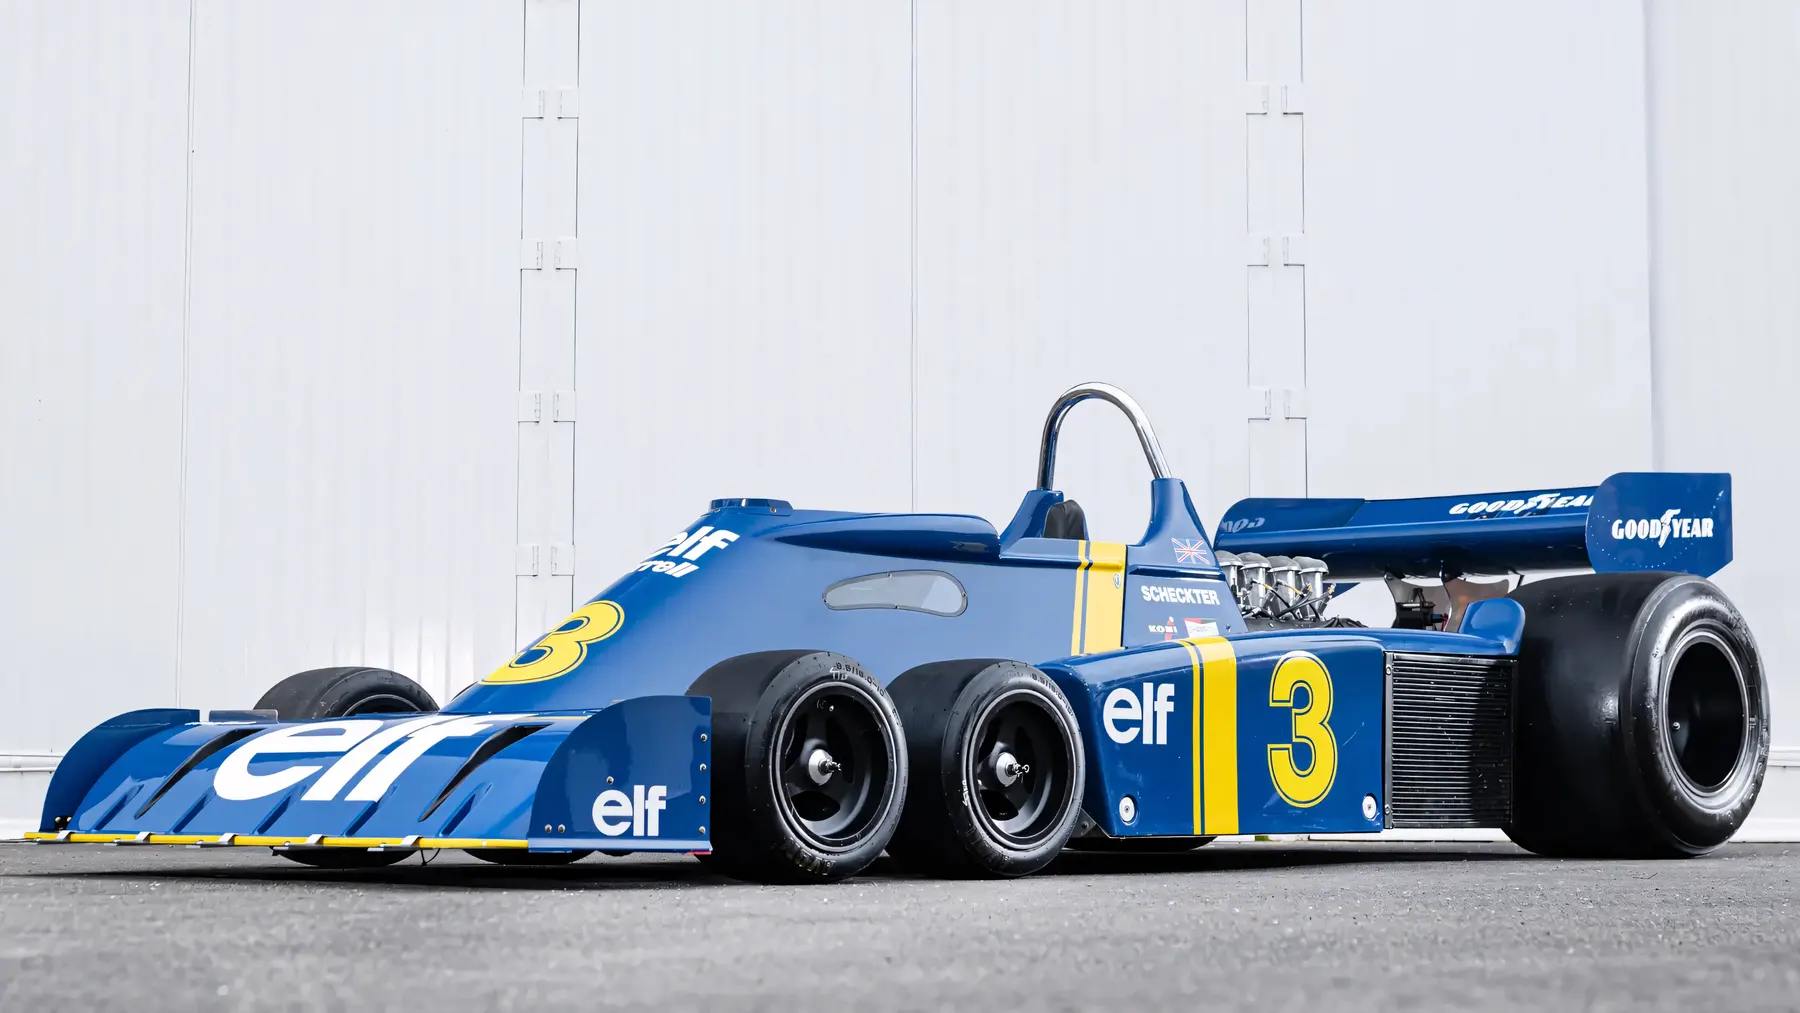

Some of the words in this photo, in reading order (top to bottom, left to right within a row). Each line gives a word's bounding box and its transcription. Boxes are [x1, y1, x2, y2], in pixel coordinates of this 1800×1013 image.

[1141, 585, 1220, 605] SCHECKTER
[1102, 682, 1175, 745] elf
[1267, 650, 1338, 808] 3
[213, 714, 528, 802] elf
[592, 785, 667, 836] elf
